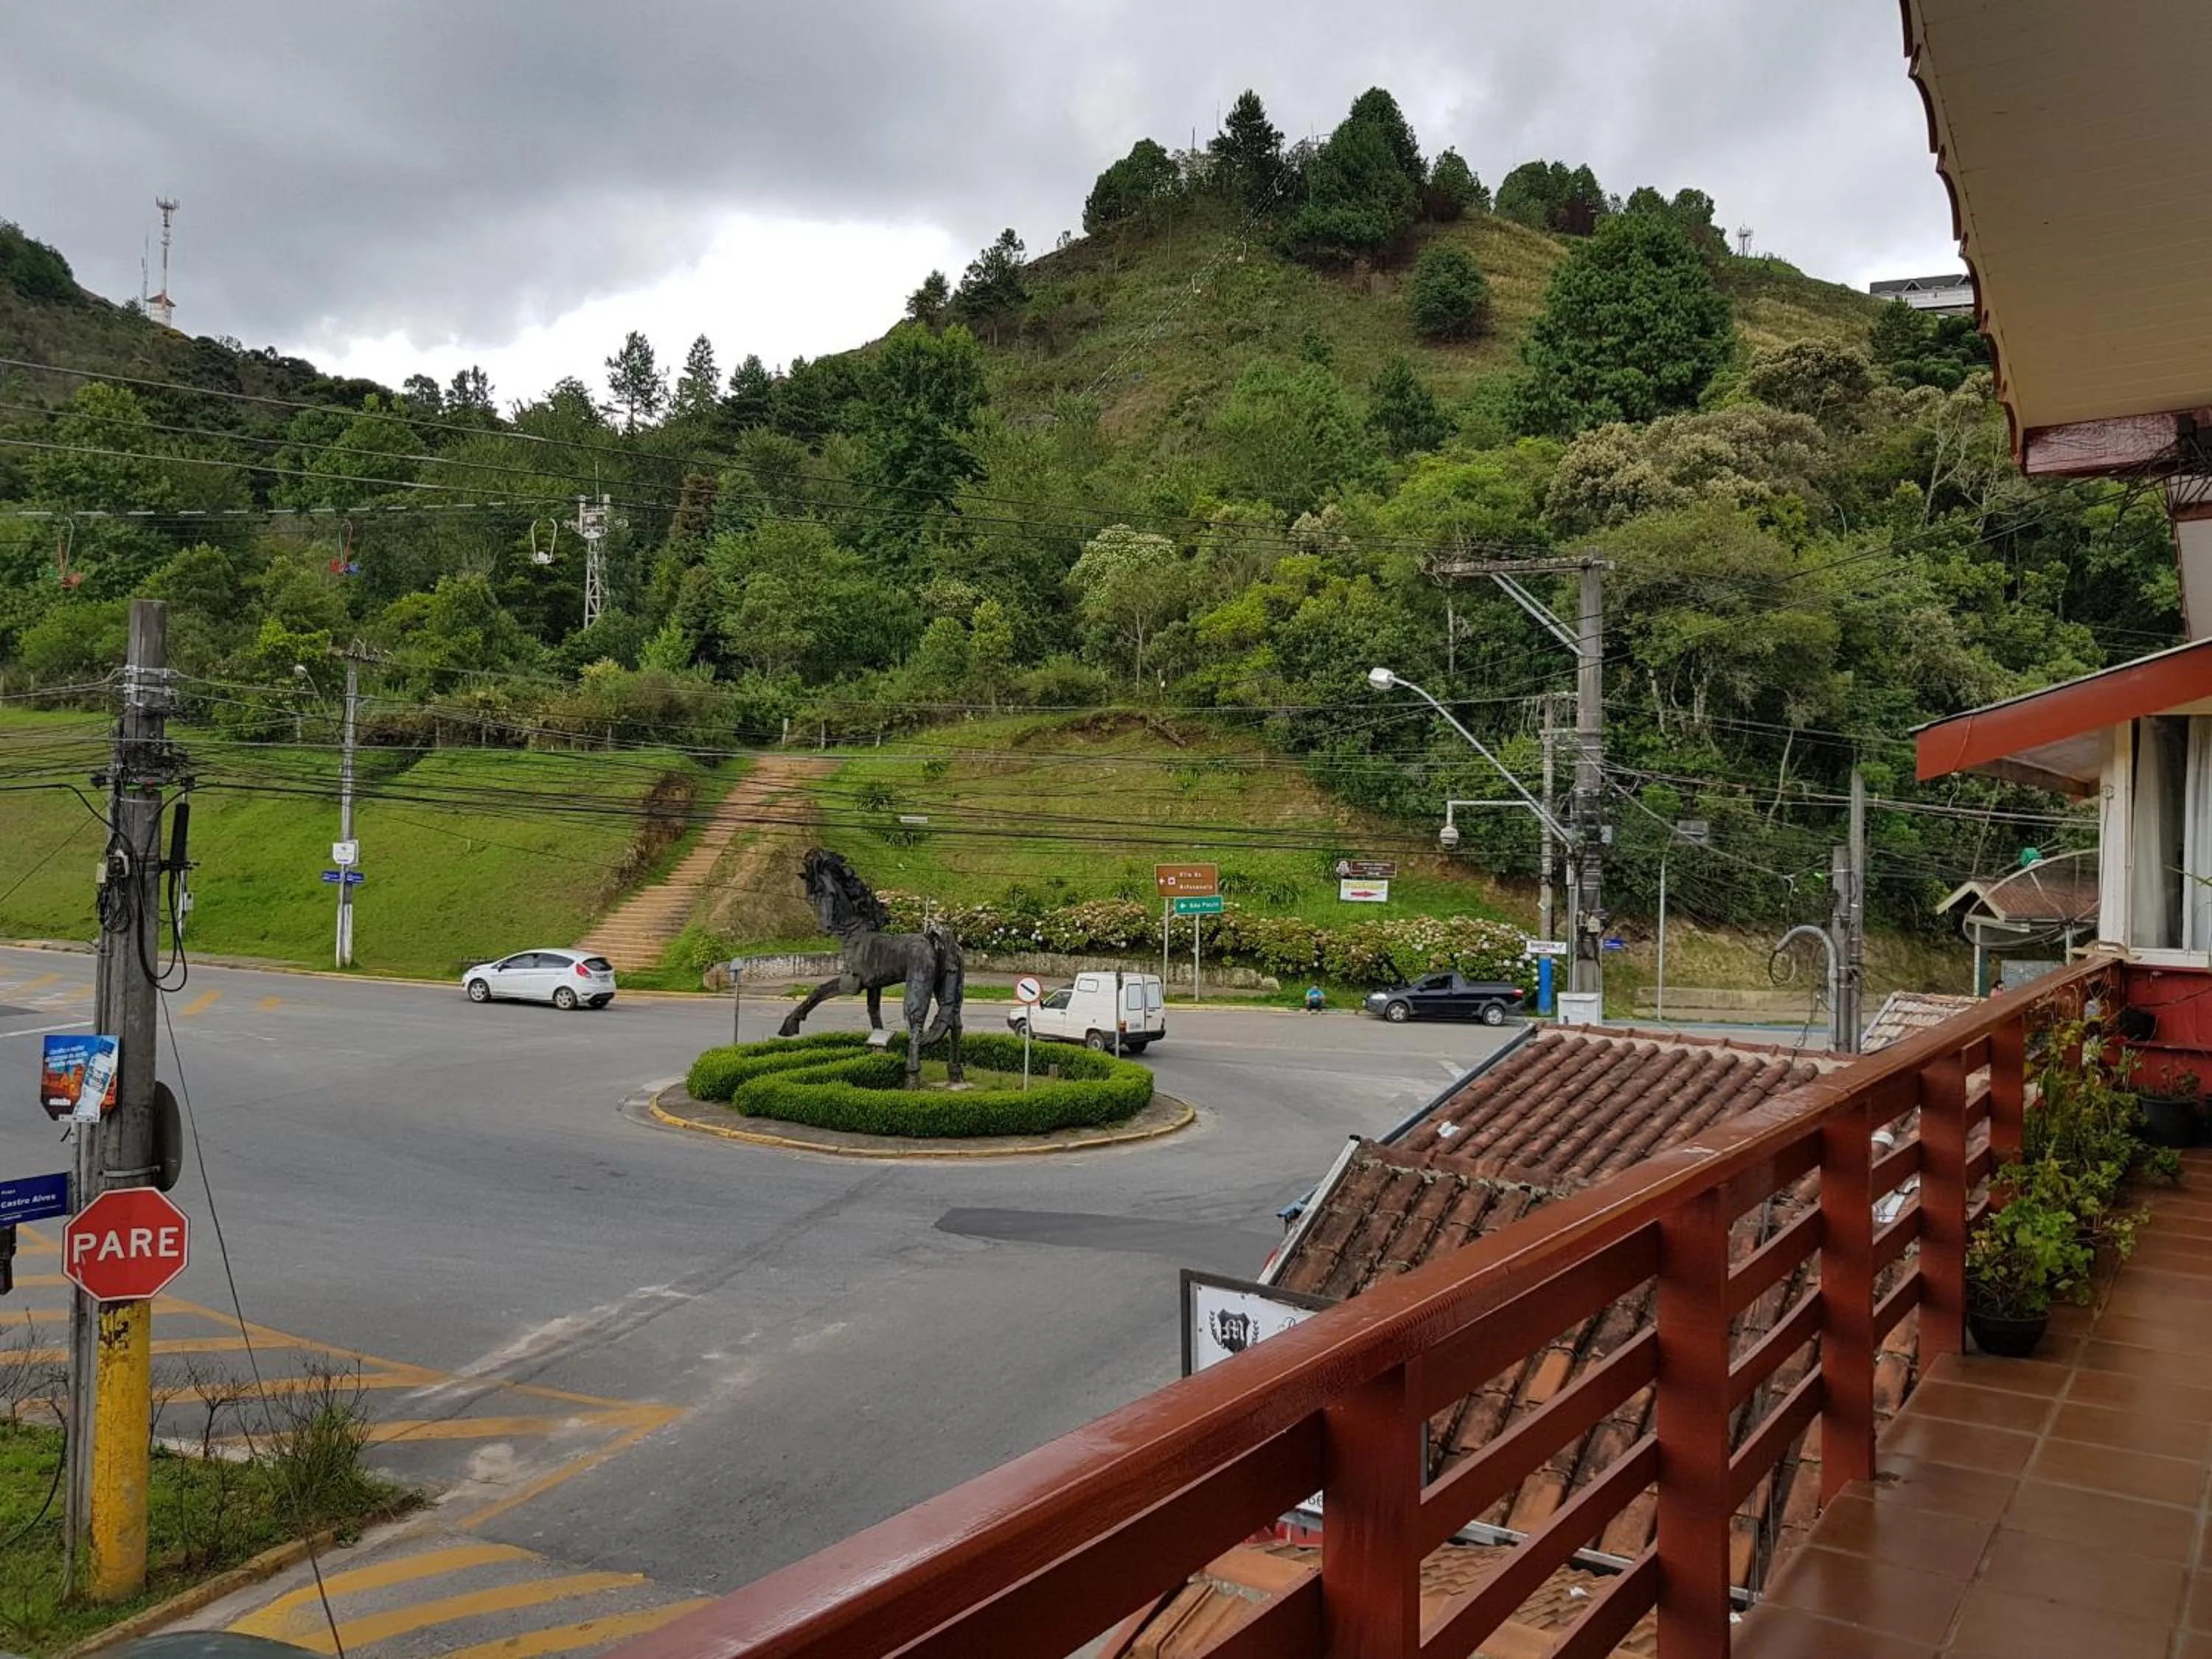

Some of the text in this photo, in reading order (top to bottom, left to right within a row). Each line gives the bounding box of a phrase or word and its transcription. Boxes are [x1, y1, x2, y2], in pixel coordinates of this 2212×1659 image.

[1, 1194, 56, 1208] Castro Alves
[73, 1226, 179, 1264] PARE
